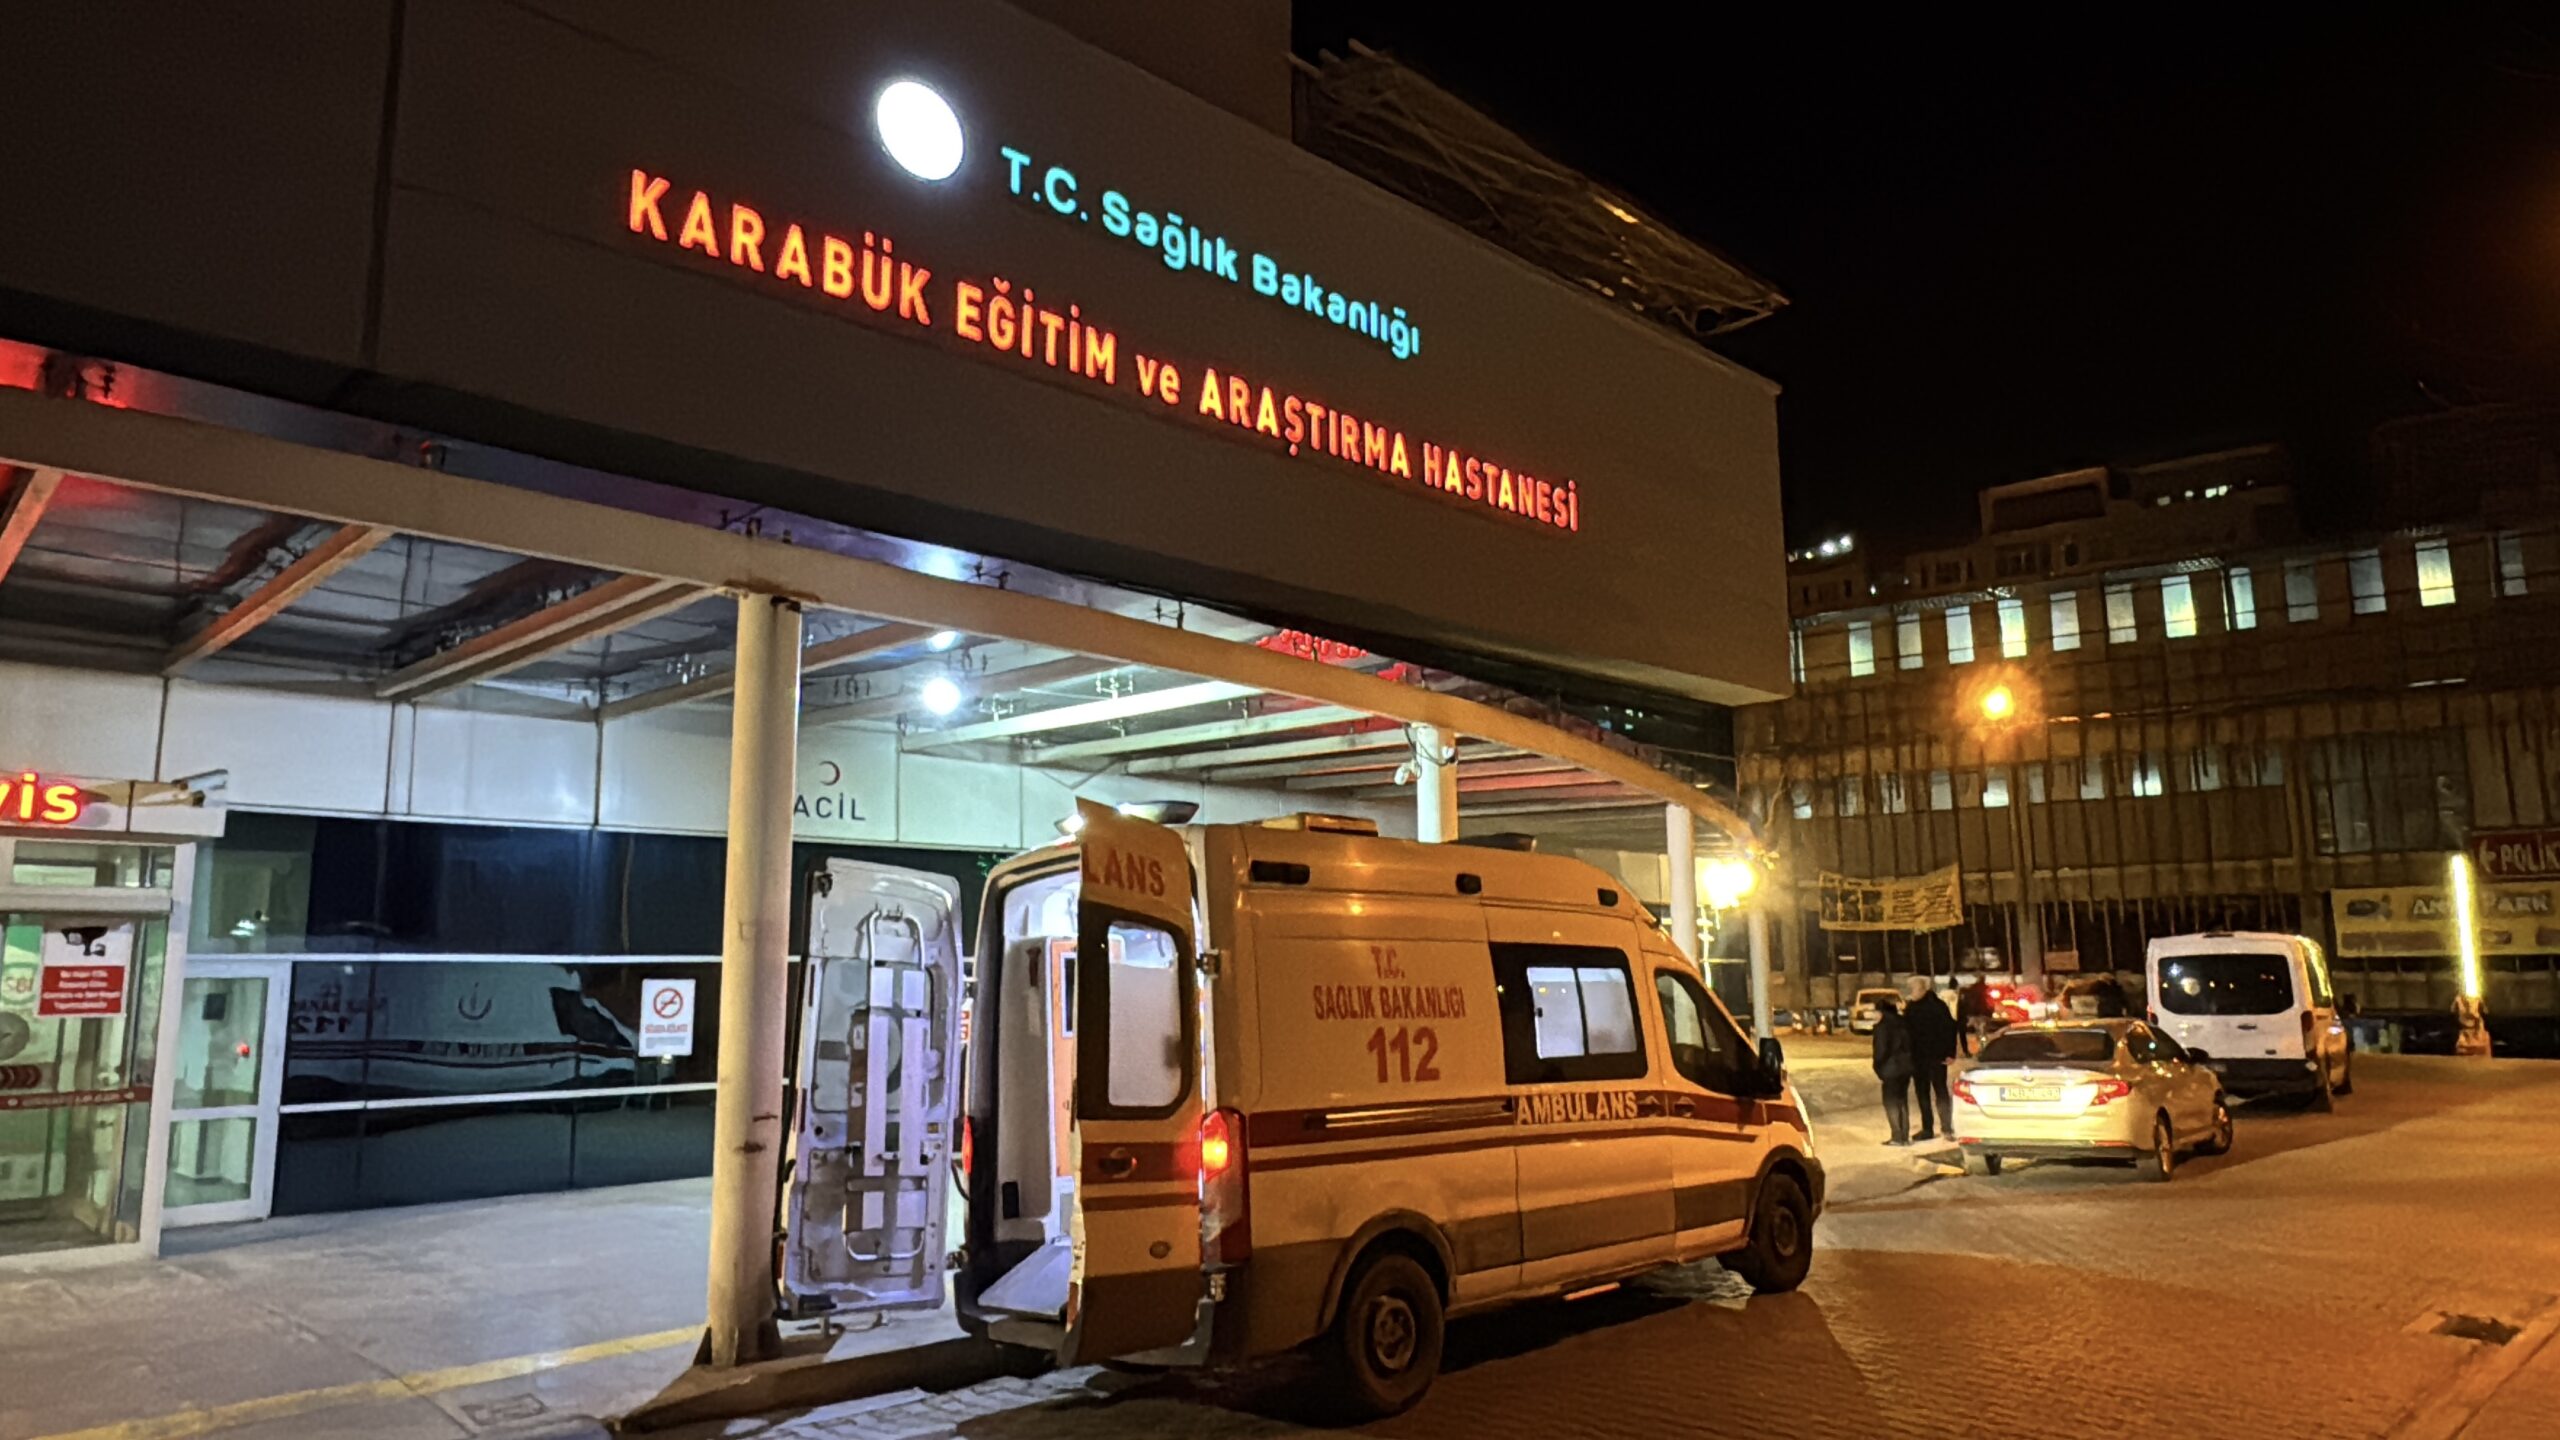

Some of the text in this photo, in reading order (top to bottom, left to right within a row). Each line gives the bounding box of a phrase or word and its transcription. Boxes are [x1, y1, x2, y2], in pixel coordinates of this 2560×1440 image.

[1002, 146, 1421, 361] T.C. Sağlık Bakanlığı
[629, 168, 1580, 532] KARABÜK EĞİTİM ve ARAŞTIRMA HASTANESİ
[793, 791, 867, 822] ACİL
[1081, 842, 1165, 897] LANS
[1366, 1026, 1441, 1083] 112
[1516, 1091, 1639, 1126] AMBULANS
